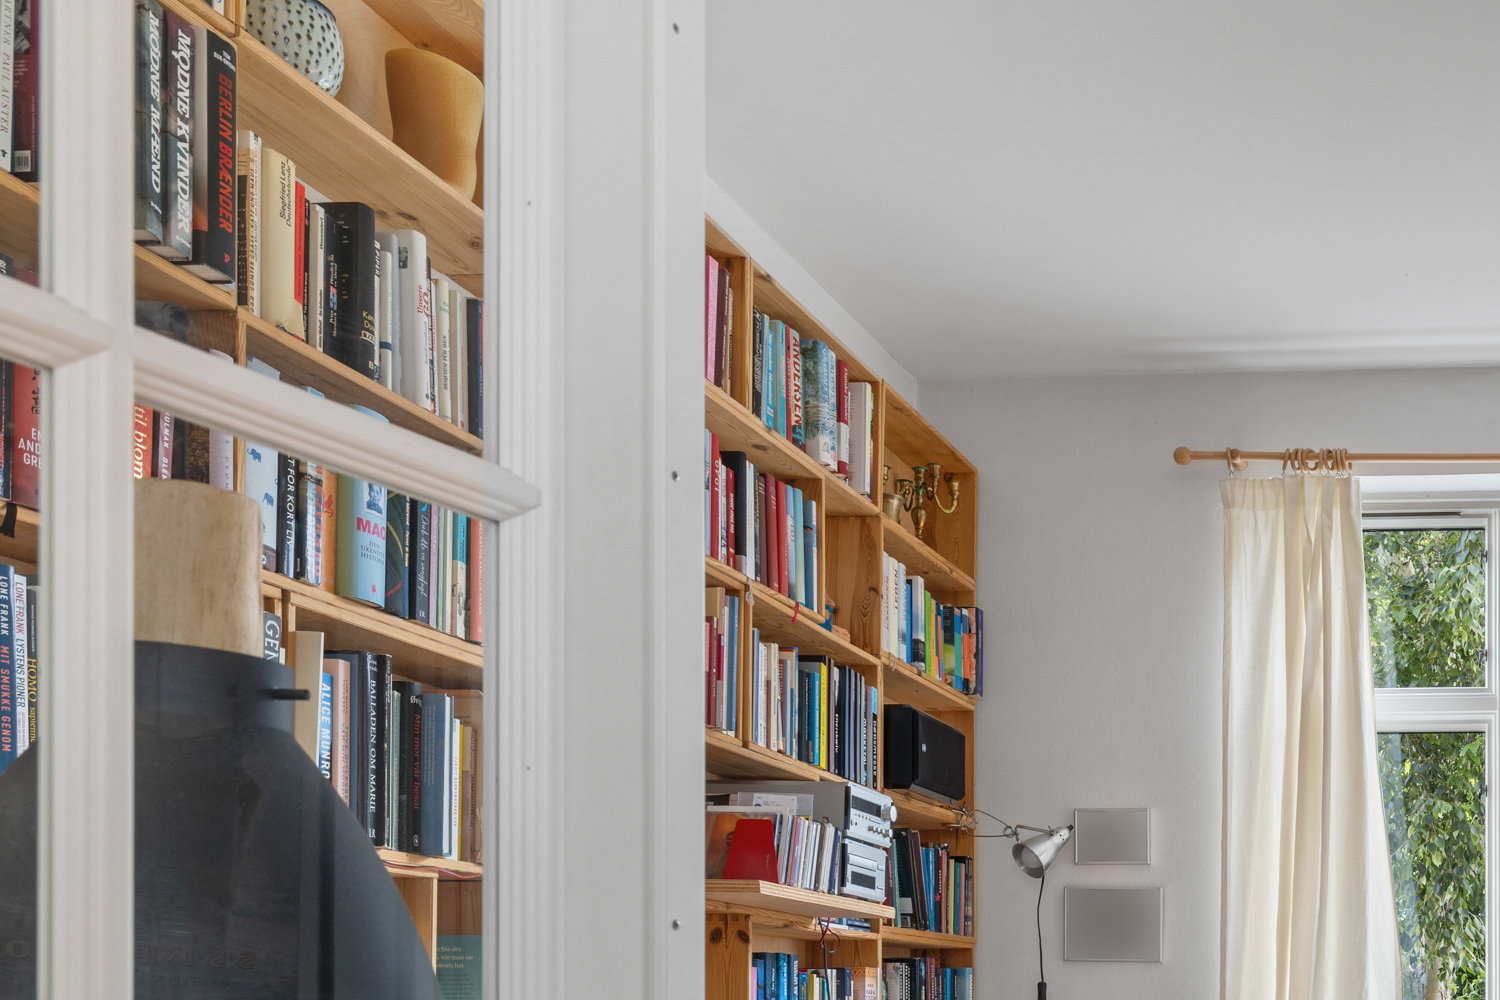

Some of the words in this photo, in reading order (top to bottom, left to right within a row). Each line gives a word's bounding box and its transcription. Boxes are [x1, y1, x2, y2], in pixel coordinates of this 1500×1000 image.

[1, 52, 11, 84] PAUL
[148, 10, 161, 102] MØDNE
[173, 29, 191, 118] MØDNE
[0, 88, 10, 134] AUSTER
[218, 73, 233, 142] BERLIN
[149, 104, 162, 194] MÆND
[177, 119, 191, 236] KVINDER
[218, 145, 233, 234] BRÆNDER
[793, 336, 802, 425] ANDERSEN
[134, 430, 147, 478] blom
[287, 468, 295, 493] FOR
[286, 494, 295, 526] KORT
[285, 527, 293, 547] LIV
[15, 581, 24, 605] LONE
[1, 603, 9, 636] FRANK
[15, 605, 25, 634] FRANK
[1, 646, 10, 662] MIT
[15, 638, 26, 674] LYSTENS
[1, 668, 11, 712] SMUKKE
[16, 677, 26, 708] PIONER
[27, 657, 37, 702] HOMO
[320, 681, 332, 726] ALICE
[369, 680, 378, 744] BALLADEN
[2, 715, 12, 752] GENOM
[414, 713, 422, 735] Min
[369, 748, 377, 769] OM
[413, 737, 421, 758] mor
[413, 761, 421, 780] var
[369, 773, 377, 813] MARIE
[413, 781, 421, 811] besat
